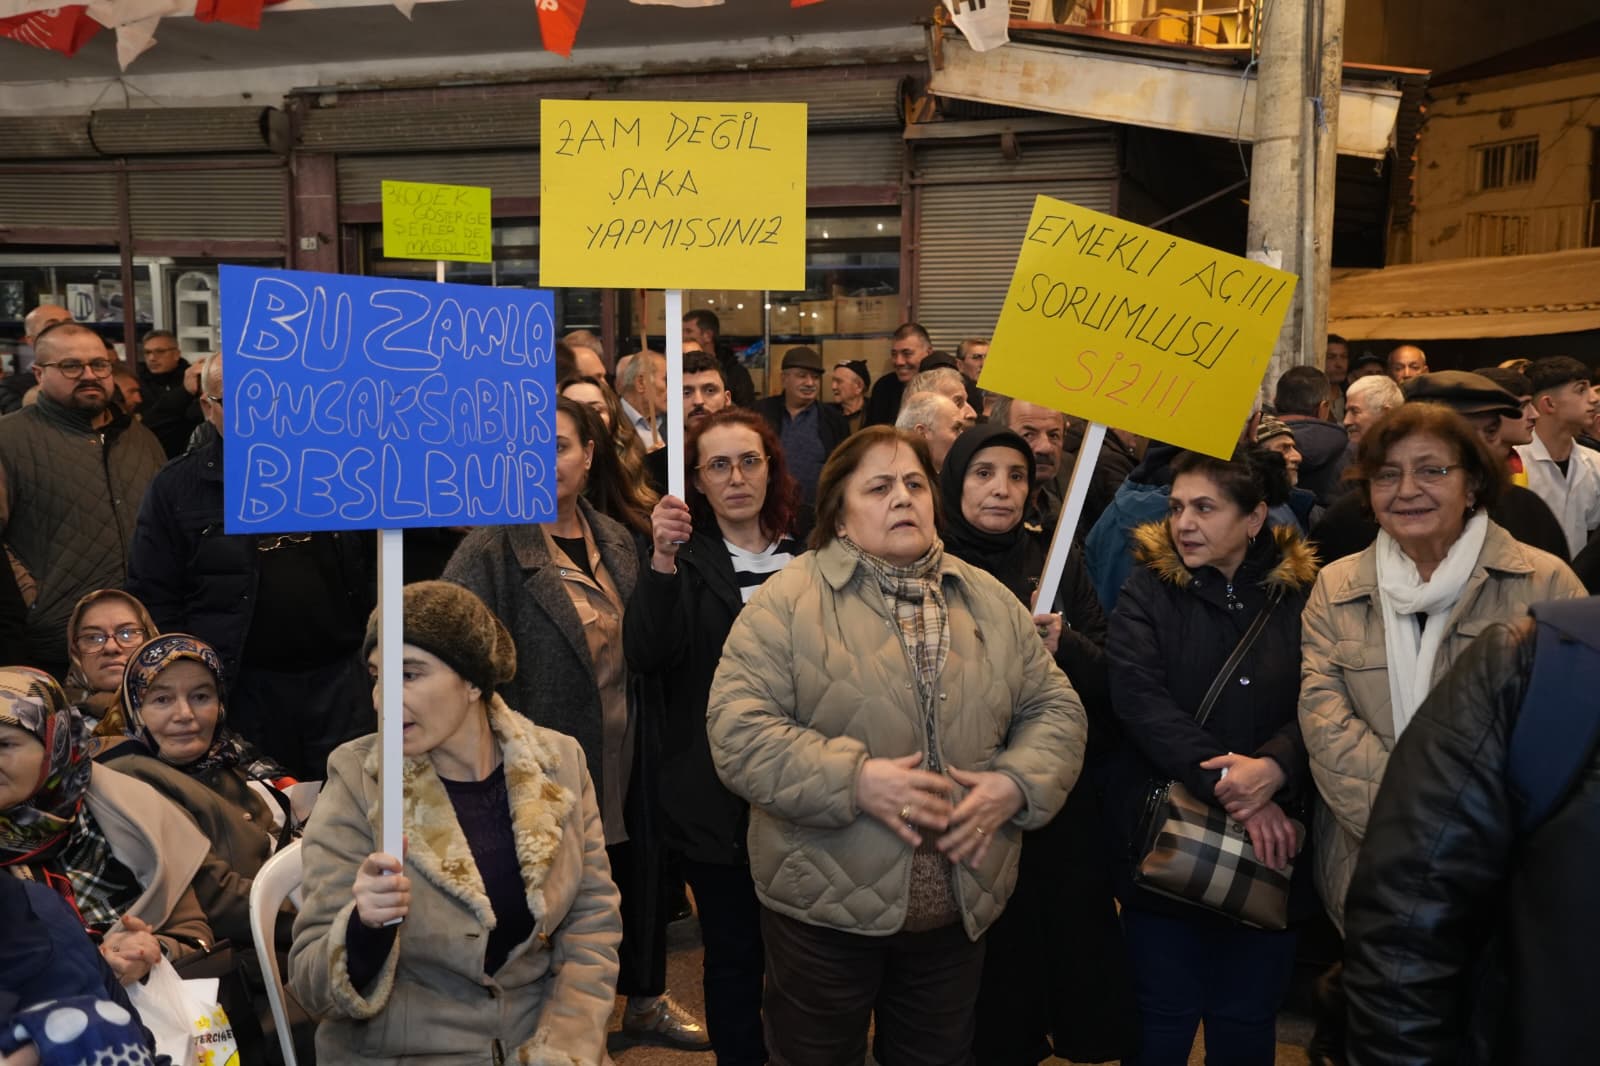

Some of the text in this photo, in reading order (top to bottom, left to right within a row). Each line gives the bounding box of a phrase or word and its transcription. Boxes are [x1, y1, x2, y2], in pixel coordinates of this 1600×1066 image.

[555, 111, 772, 157] ZAM DEĞİL
[609, 168, 699, 205] ŞAKA
[586, 216, 782, 251] YAPMIŞSINIZ
[1028, 215, 1177, 277] EMEKLİ
[236, 277, 555, 372] BU ZAMLA
[1017, 273, 1239, 370] SORUMLUSU
[238, 442, 555, 524] BESLENİR
